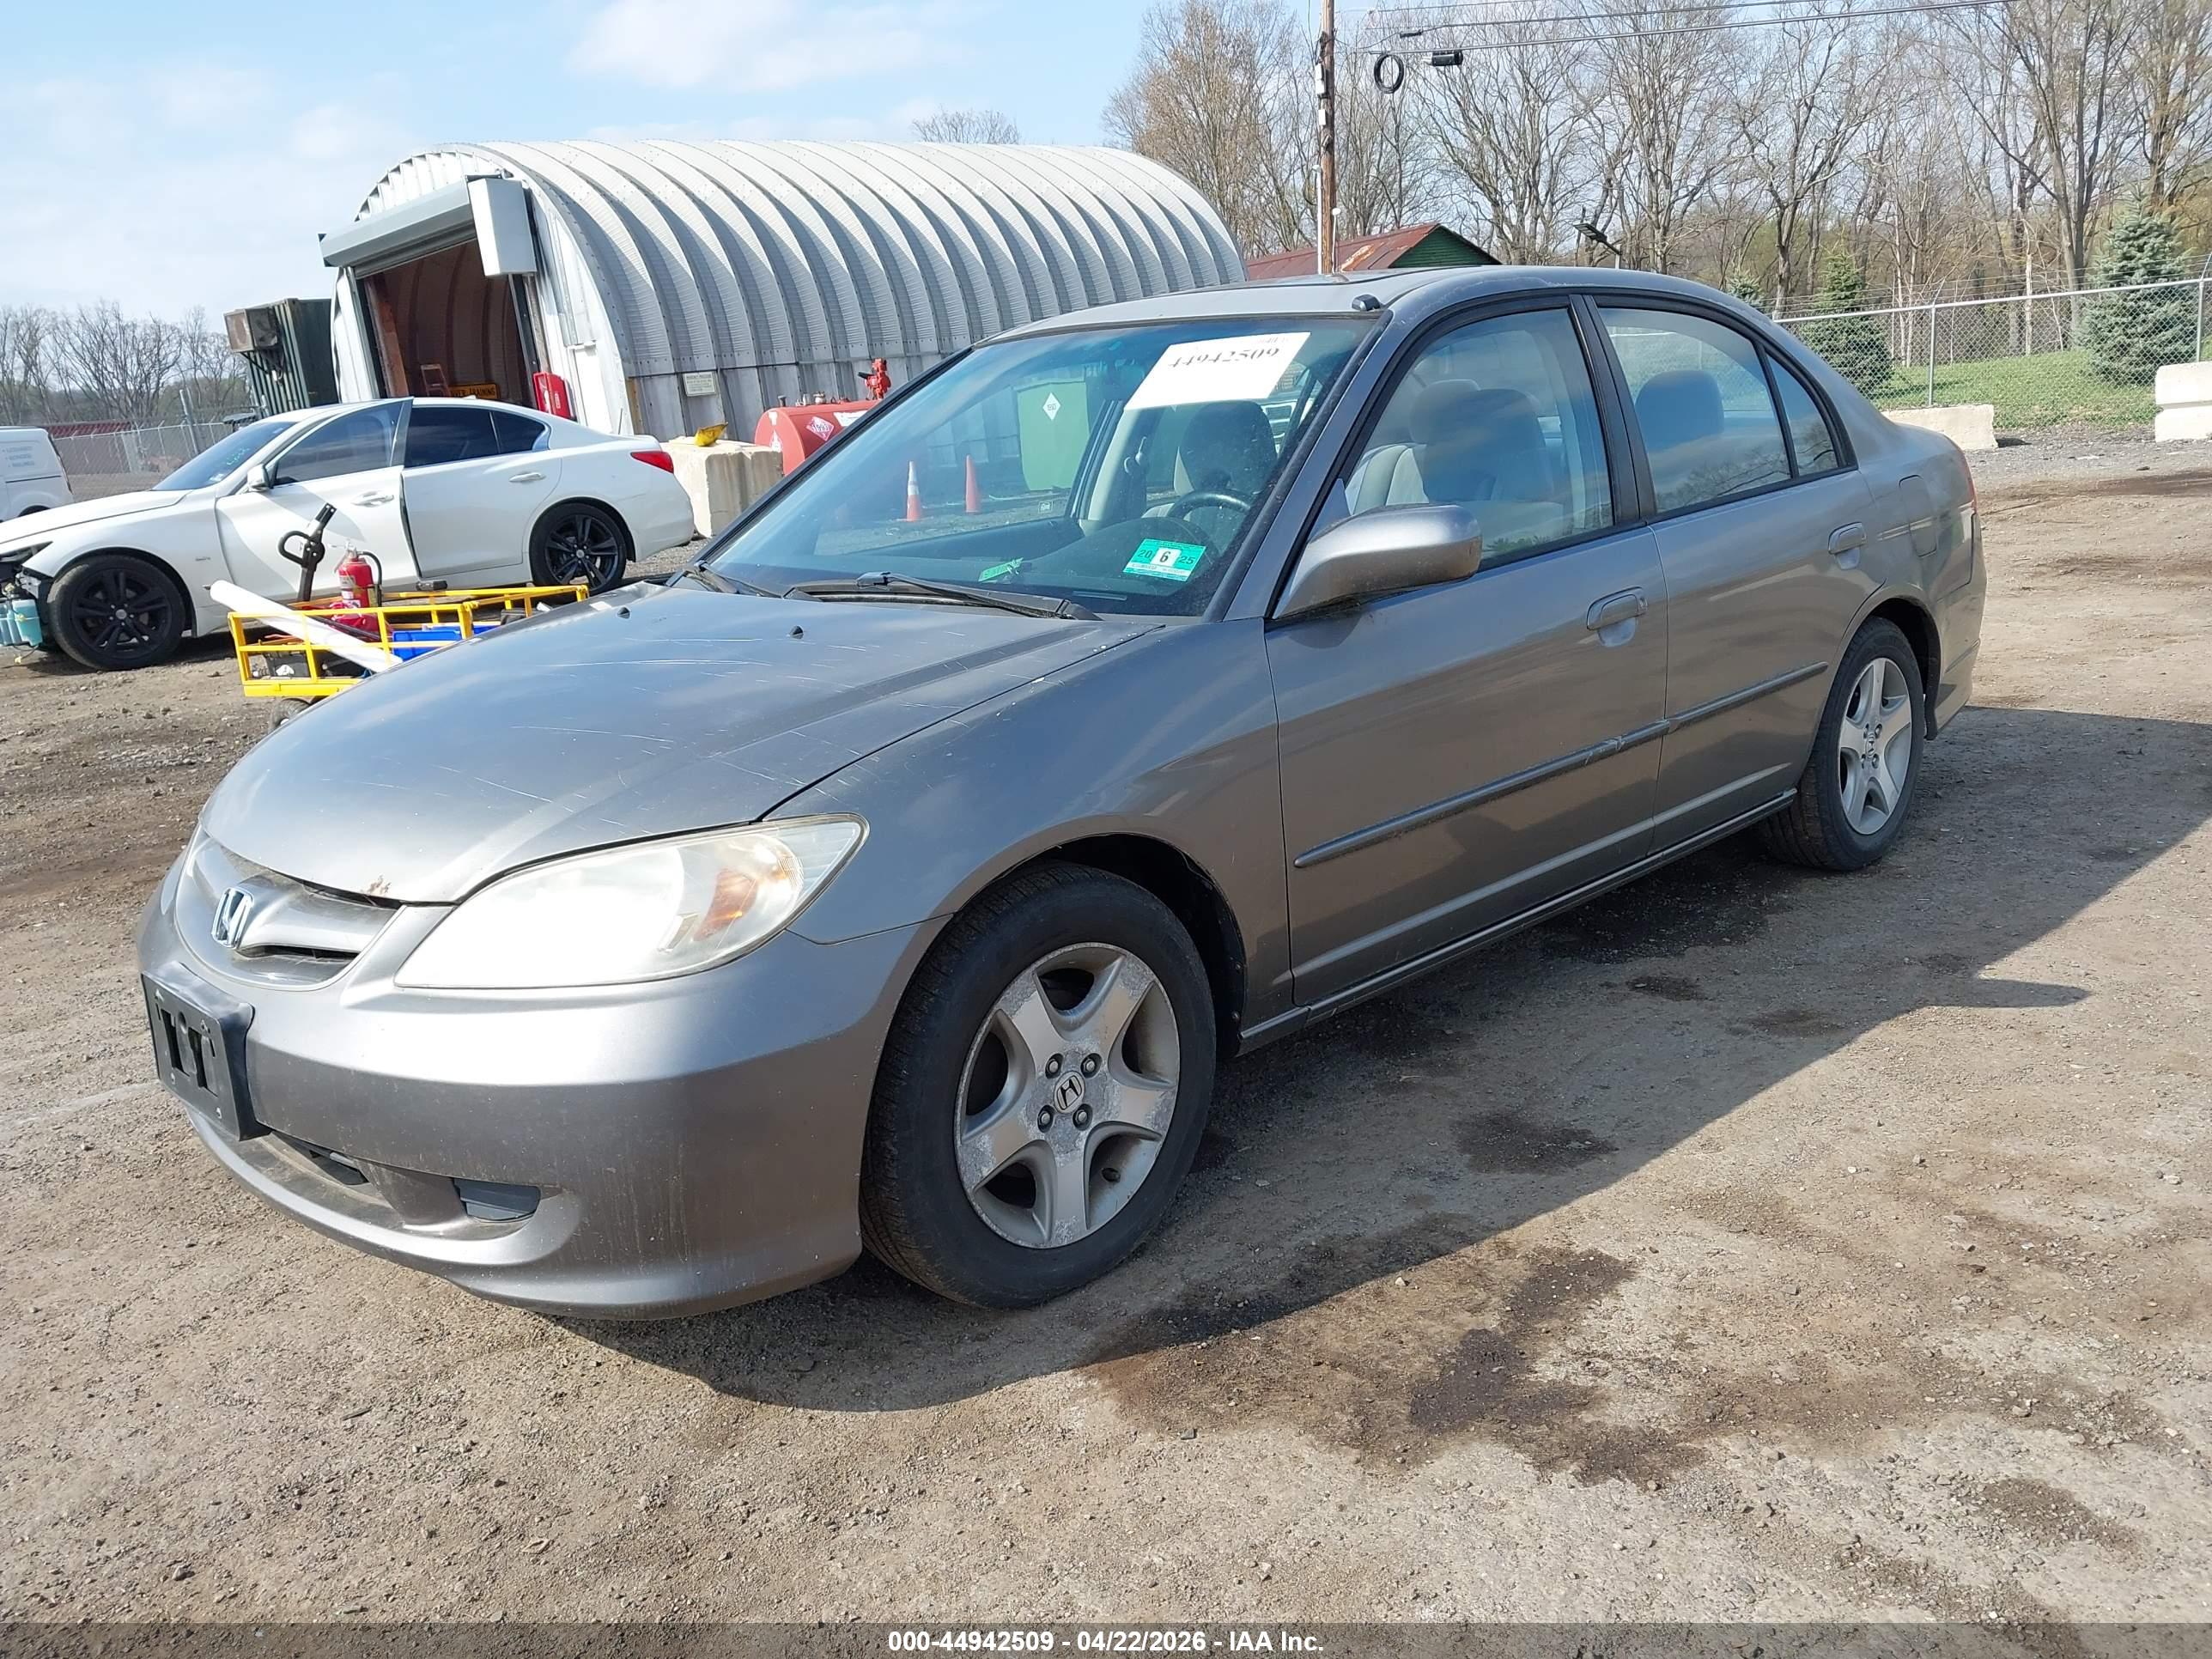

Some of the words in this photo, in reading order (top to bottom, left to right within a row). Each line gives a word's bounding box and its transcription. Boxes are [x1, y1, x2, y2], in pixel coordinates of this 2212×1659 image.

[1168, 348, 1279, 368] 44942509
[1137, 549, 1153, 559] 20
[1158, 550, 1172, 563] 6
[1177, 556, 1197, 566] 25
